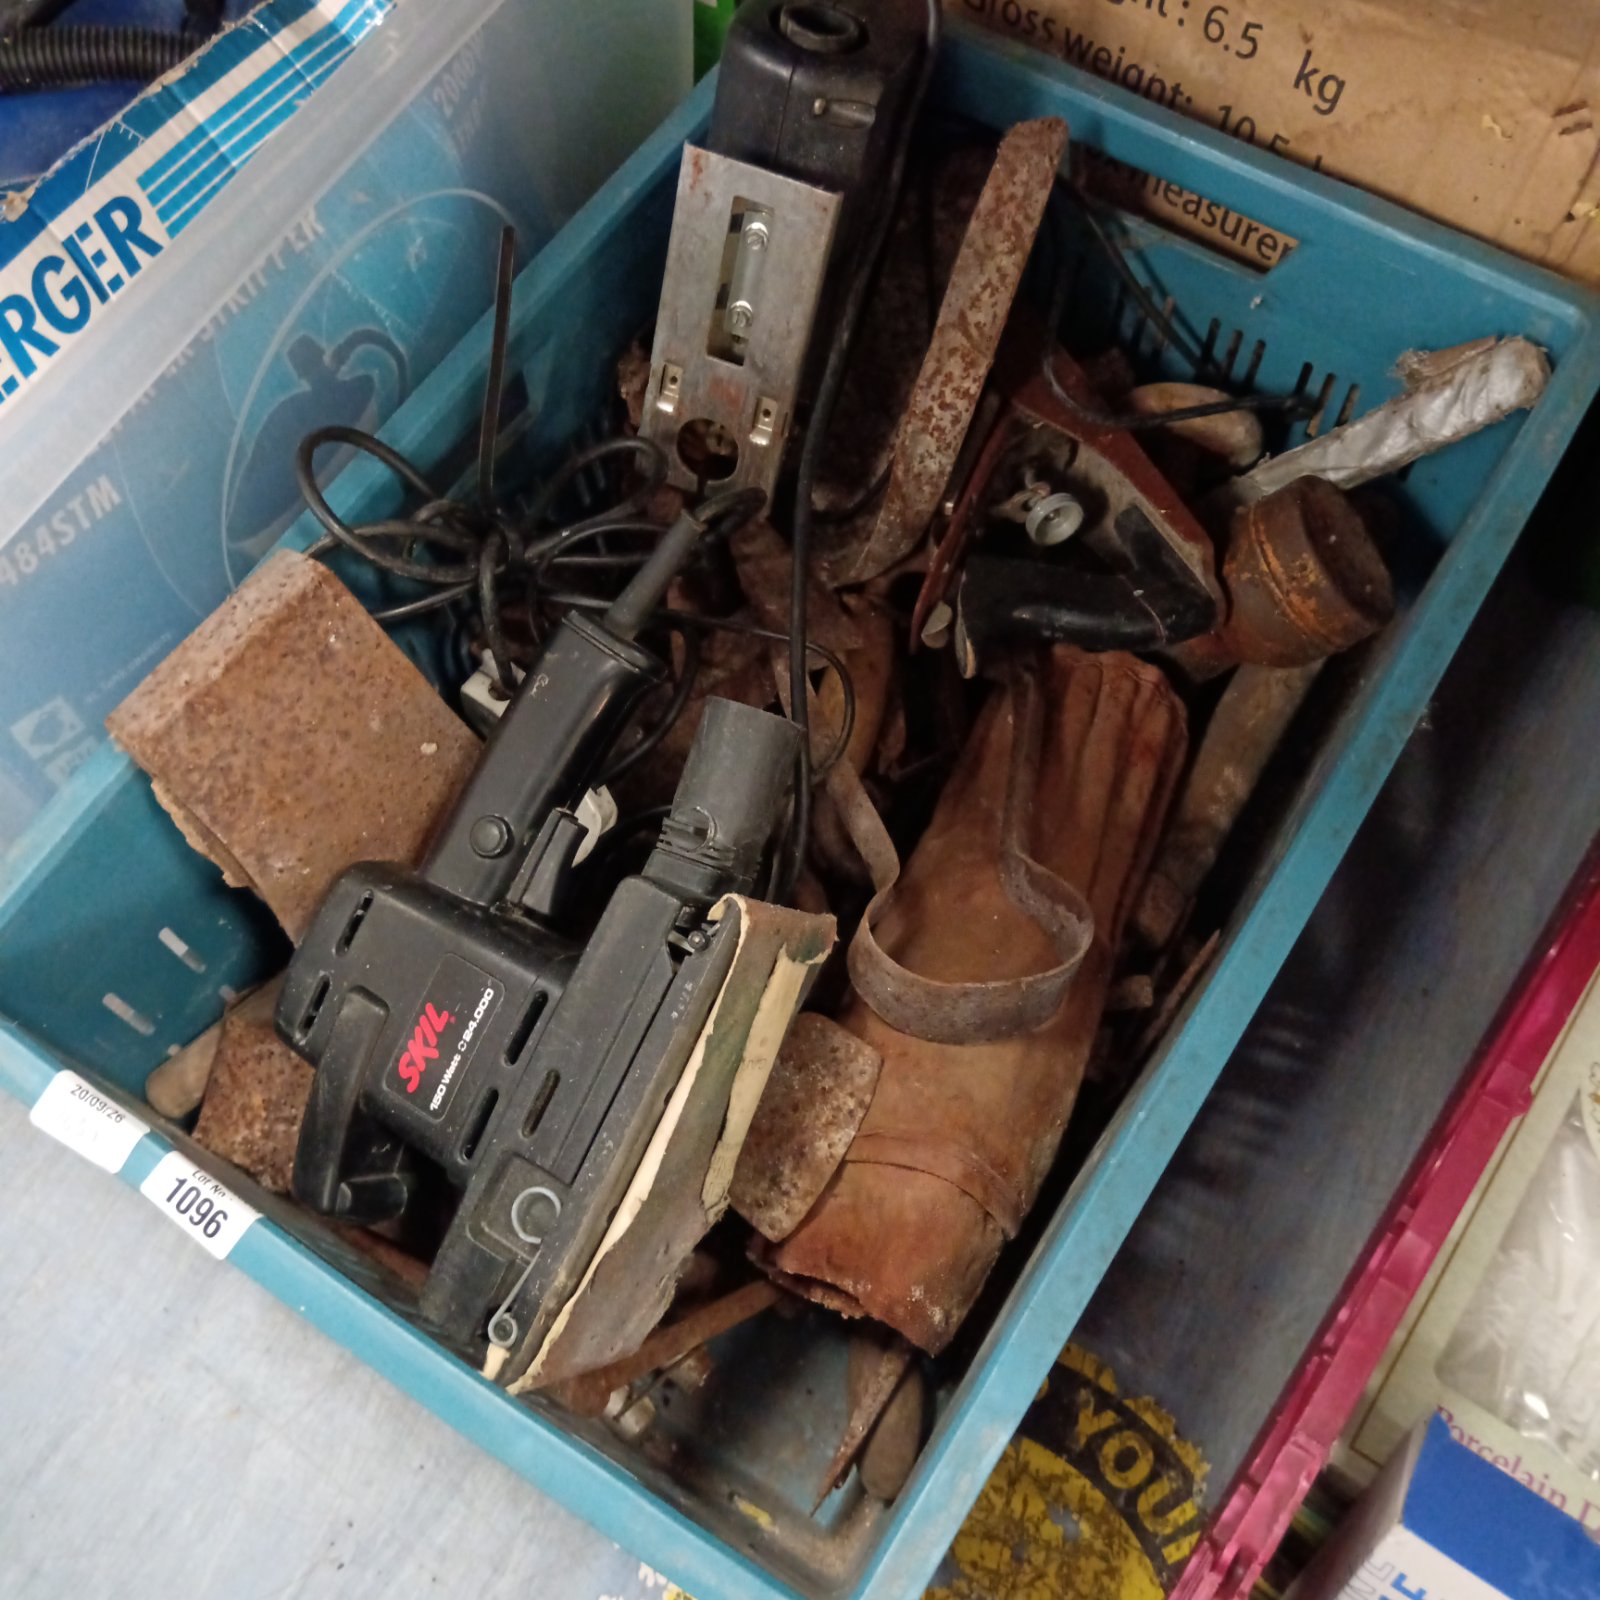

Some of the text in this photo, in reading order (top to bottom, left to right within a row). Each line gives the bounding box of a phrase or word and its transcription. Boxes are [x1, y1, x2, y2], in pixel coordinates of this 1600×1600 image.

[1203, 5, 1264, 59] 6.5
[1293, 49, 1346, 115] kg
[398, 1002, 449, 1093] SKIL
[429, 1083, 447, 1111] 150
[441, 1053, 461, 1085] Watt
[165, 1176, 229, 1239] 1096
